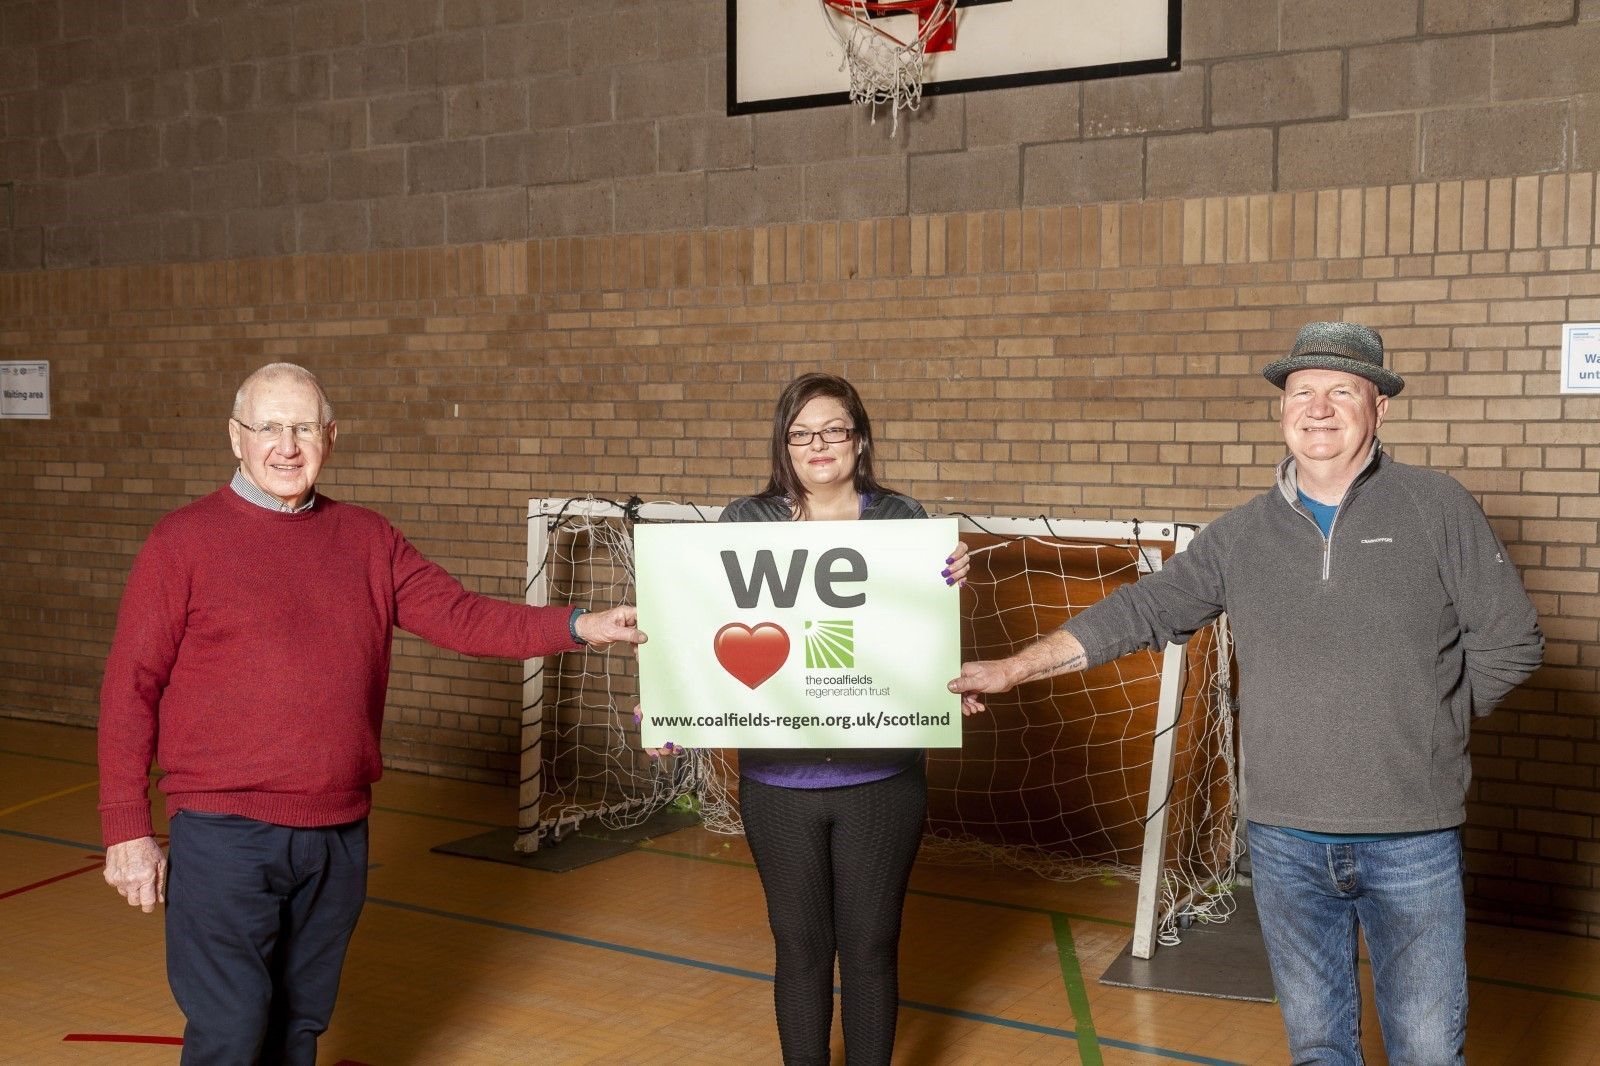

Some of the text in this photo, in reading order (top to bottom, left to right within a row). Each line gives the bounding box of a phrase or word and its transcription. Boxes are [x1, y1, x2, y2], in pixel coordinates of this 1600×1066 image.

[29, 391, 44, 399] area
[720, 547, 869, 609] we
[805, 674, 873, 685] the coalfields
[805, 686, 891, 699] regeneration trust
[651, 711, 951, 730] www.coalfields-regen.org.uk/scotland
